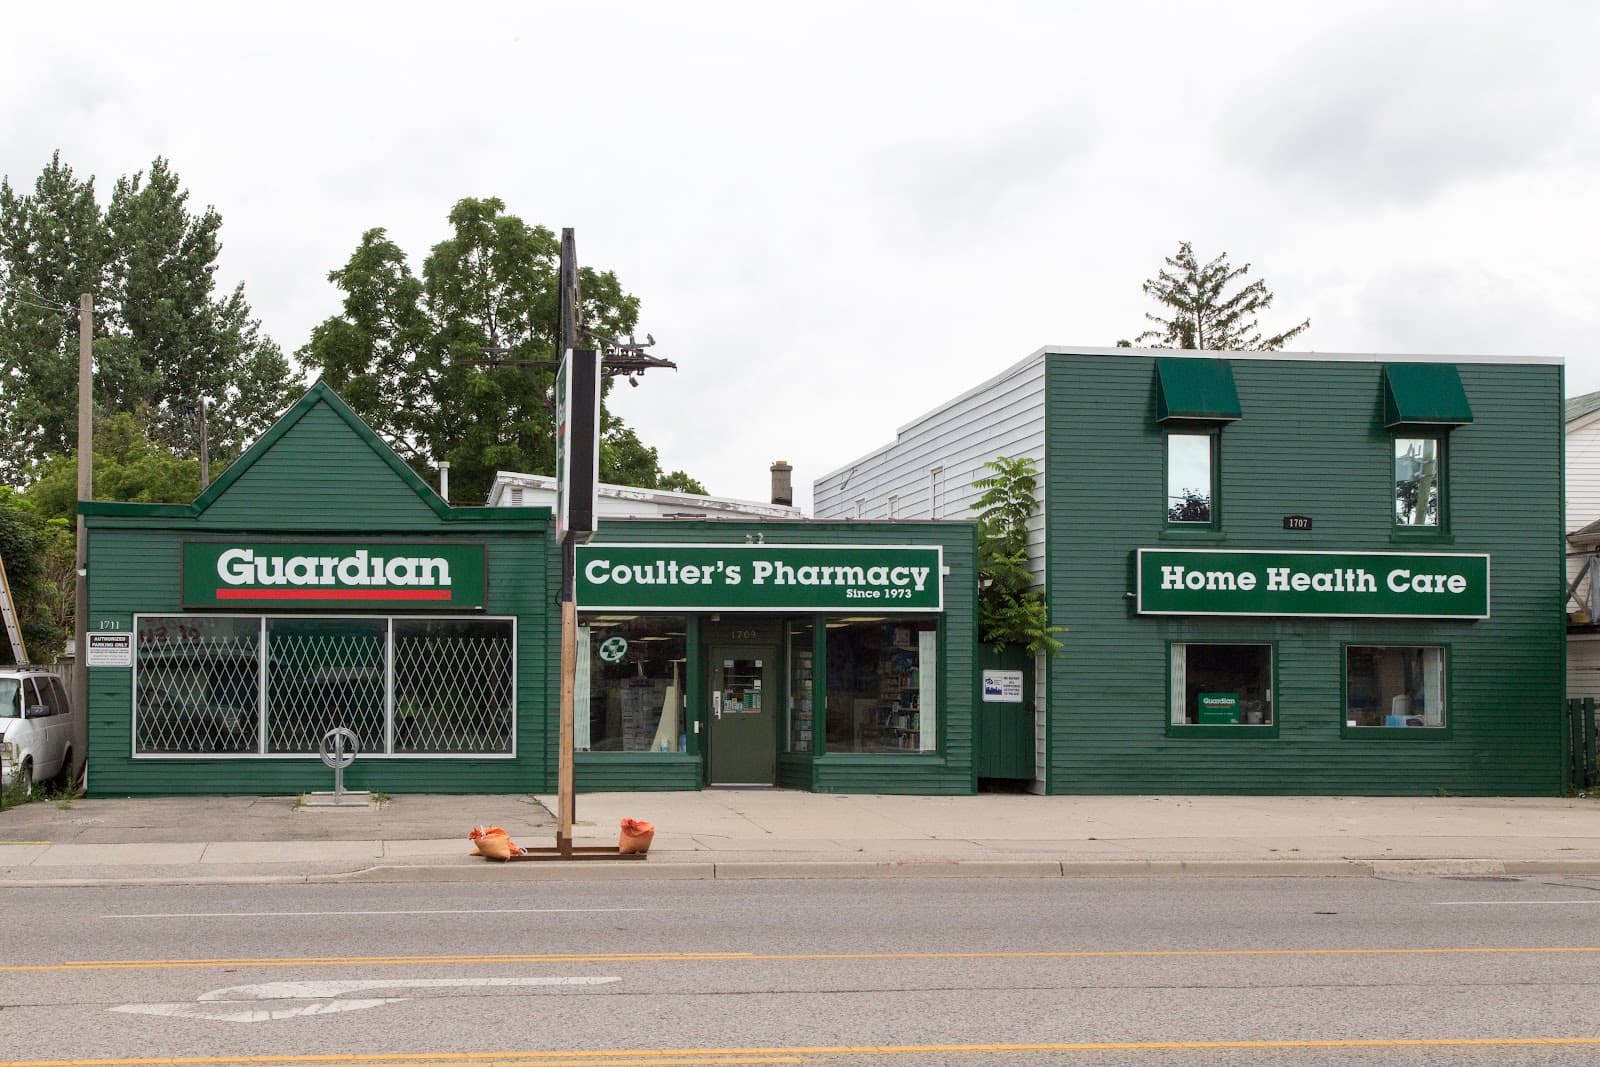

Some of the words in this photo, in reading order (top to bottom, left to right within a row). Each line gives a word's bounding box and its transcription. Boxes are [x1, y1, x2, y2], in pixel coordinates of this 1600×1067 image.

[1289, 518, 1308, 528] 1707
[216, 548, 452, 586] Guardian
[584, 559, 742, 585] Coulter's
[752, 560, 931, 591] Pharmacy
[1160, 565, 1257, 590] Home
[1266, 567, 1378, 593] Health
[1386, 568, 1467, 594] Care
[846, 588, 881, 599] Since
[884, 588, 912, 599] 1973
[100, 620, 119, 629] 1711
